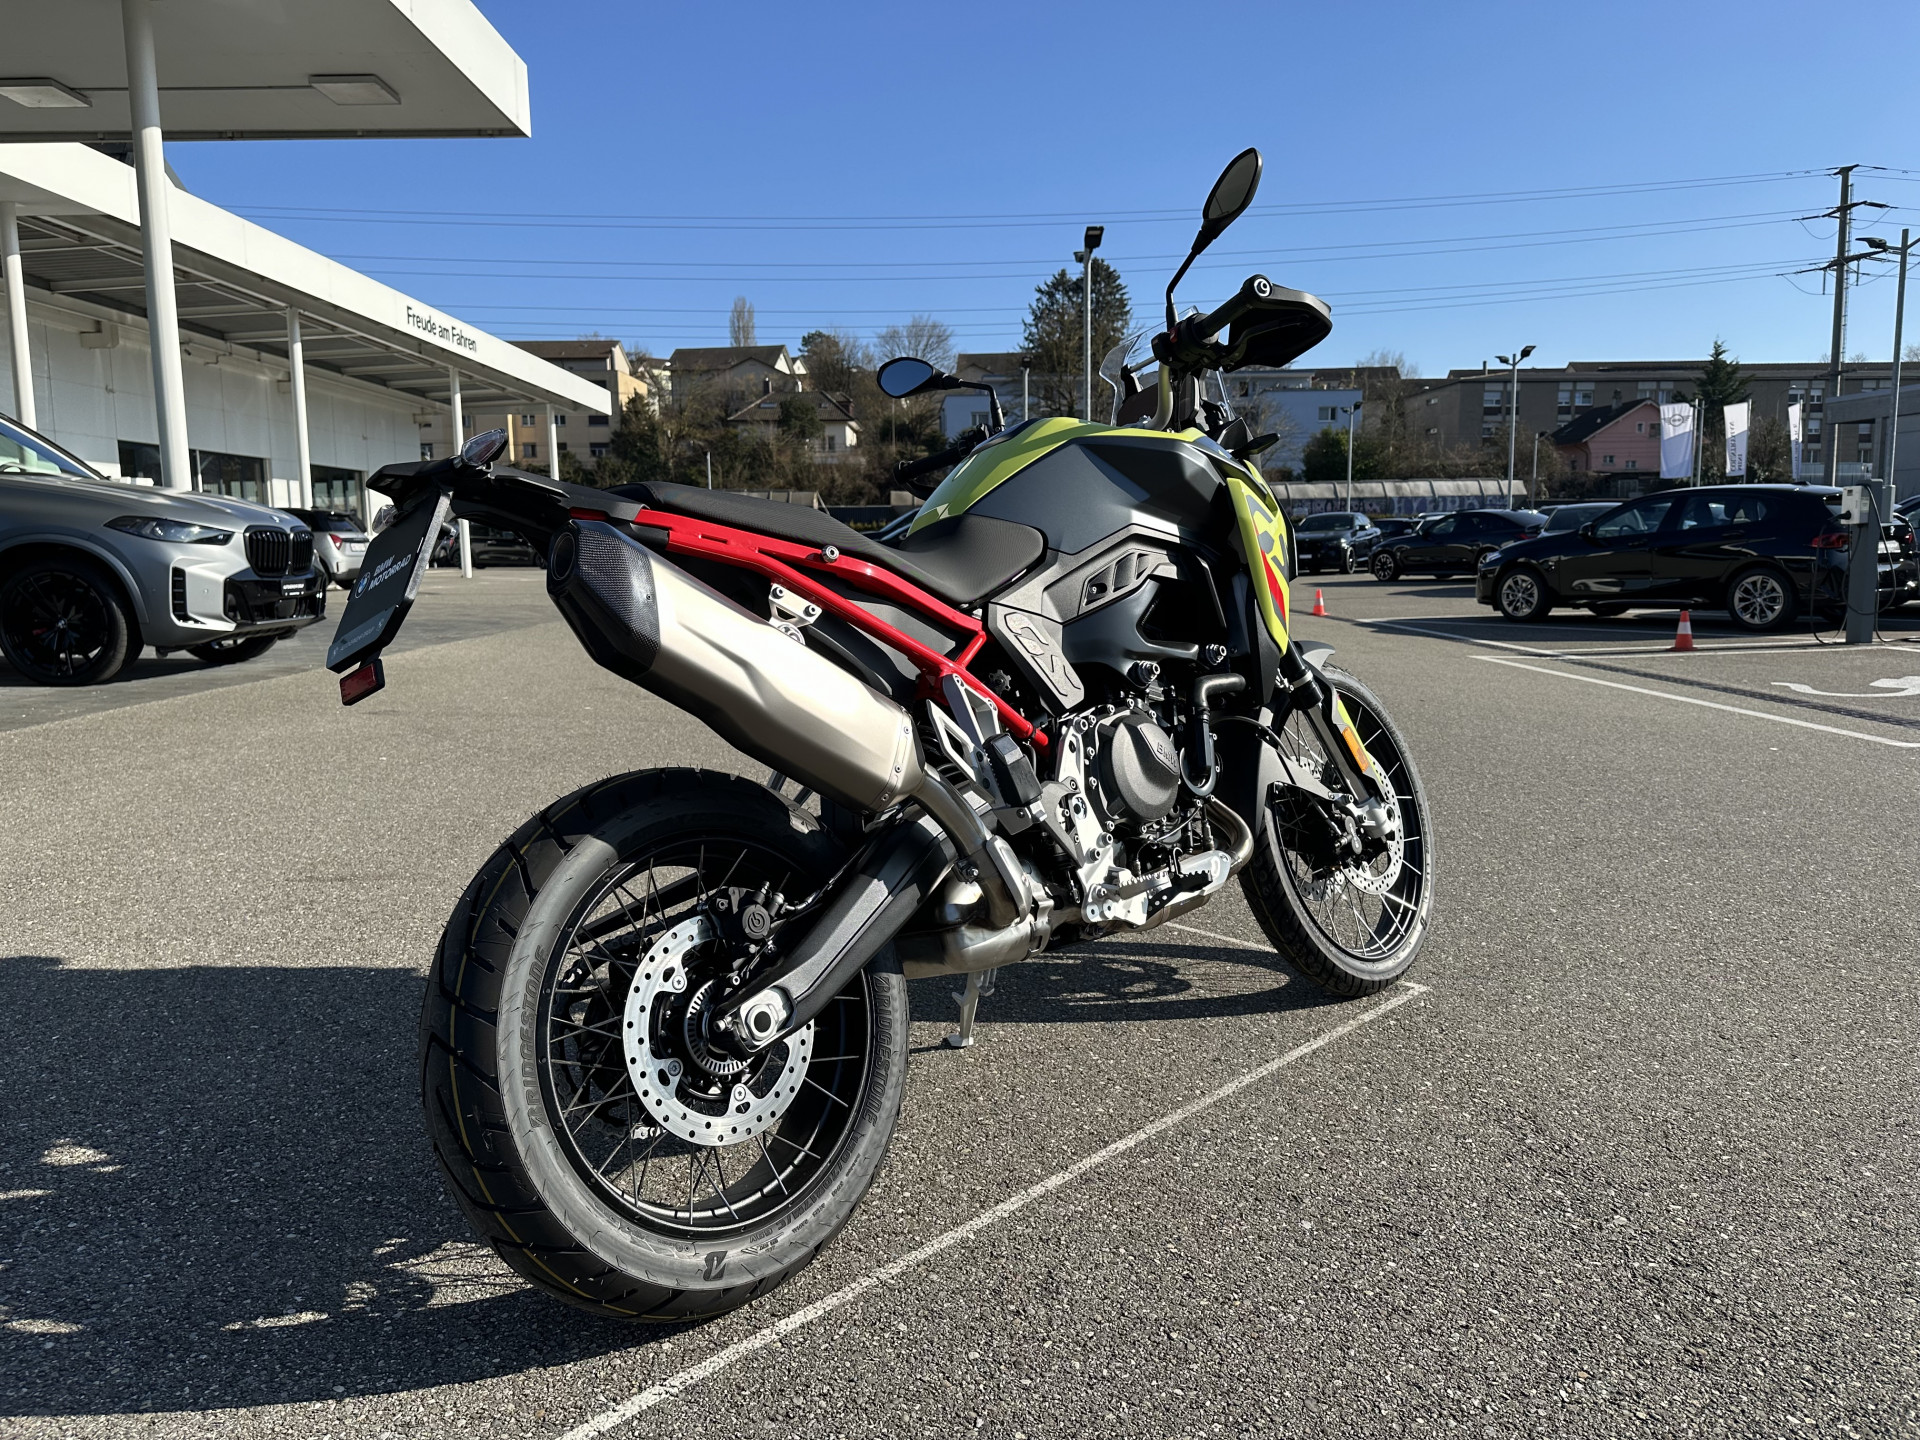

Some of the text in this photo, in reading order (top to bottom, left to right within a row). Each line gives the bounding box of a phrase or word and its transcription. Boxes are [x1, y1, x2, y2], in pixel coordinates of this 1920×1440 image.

[407, 305, 477, 352] Freude am Fahren
[368, 554, 411, 590] MOTORRAD
[373, 555, 395, 576] BMW
[1156, 742, 1177, 767] BMW
[519, 944, 549, 1128] BRIDGESTONE
[863, 975, 893, 1127] BRIDGESTONE
